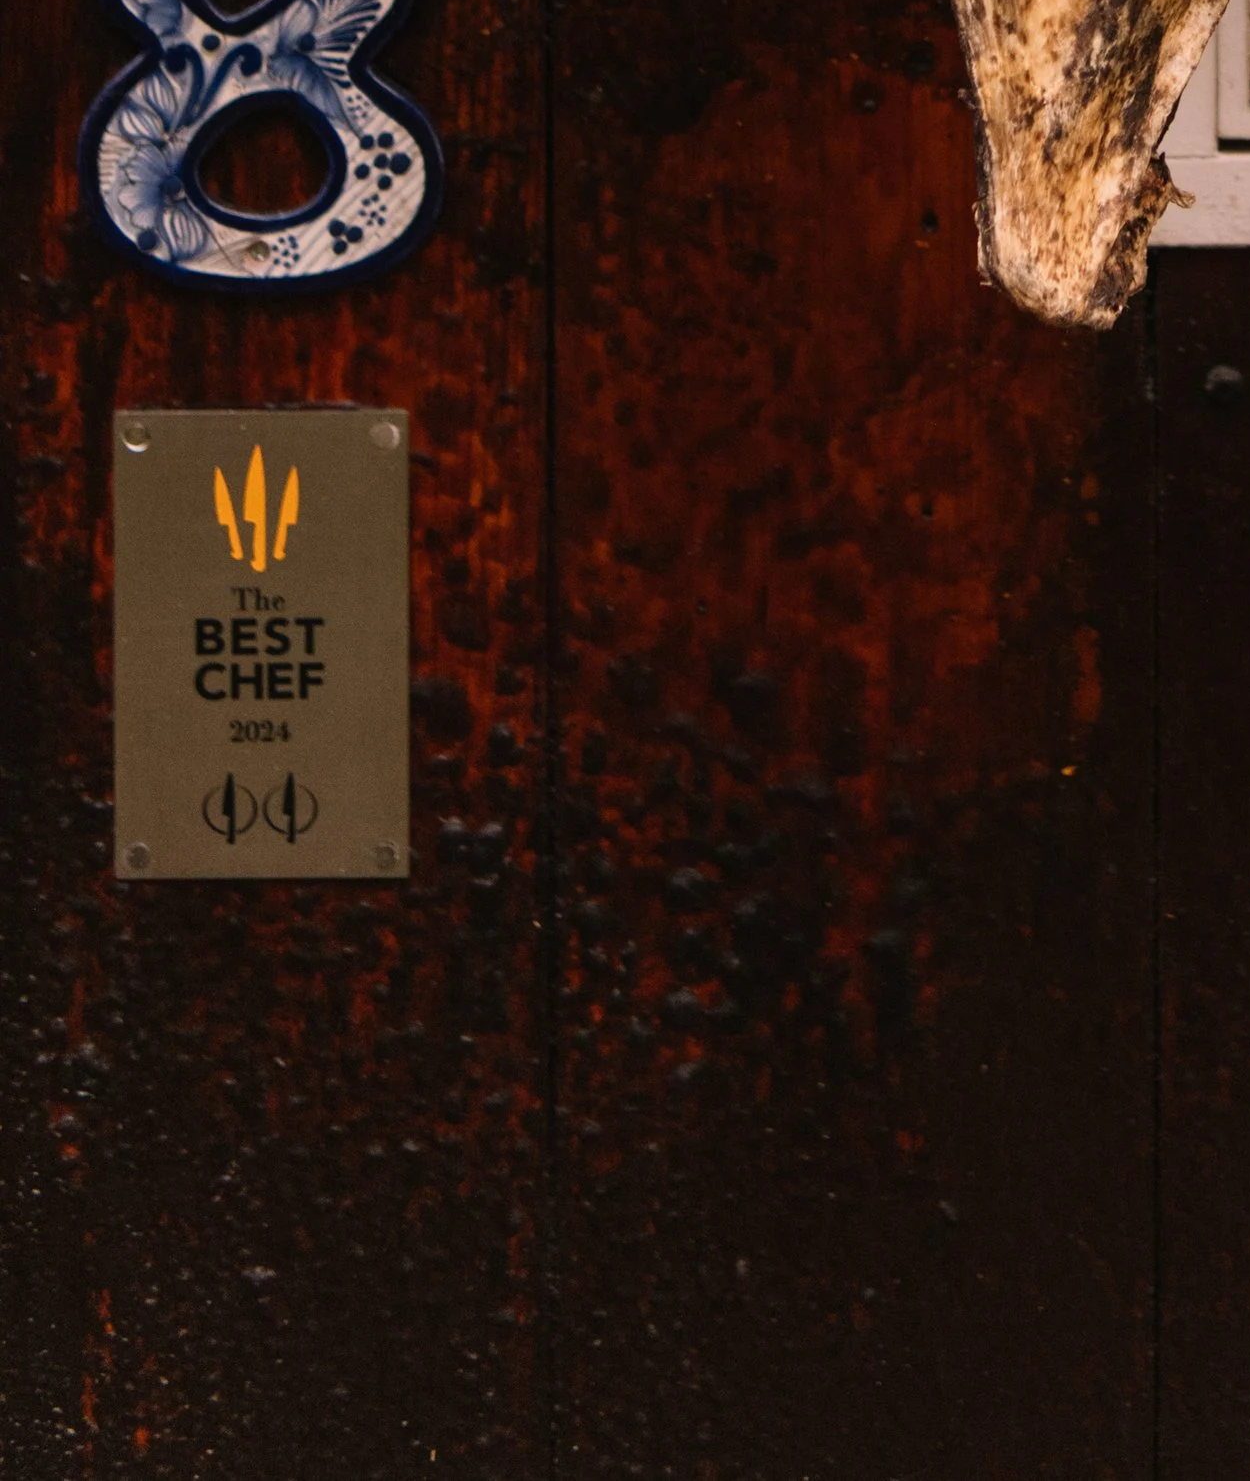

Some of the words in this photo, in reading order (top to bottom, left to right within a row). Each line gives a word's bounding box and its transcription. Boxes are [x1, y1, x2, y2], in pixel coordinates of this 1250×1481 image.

[230, 586, 286, 611] The
[194, 617, 325, 656] BEST
[194, 661, 325, 701] CHEF
[229, 719, 292, 743] 2024
